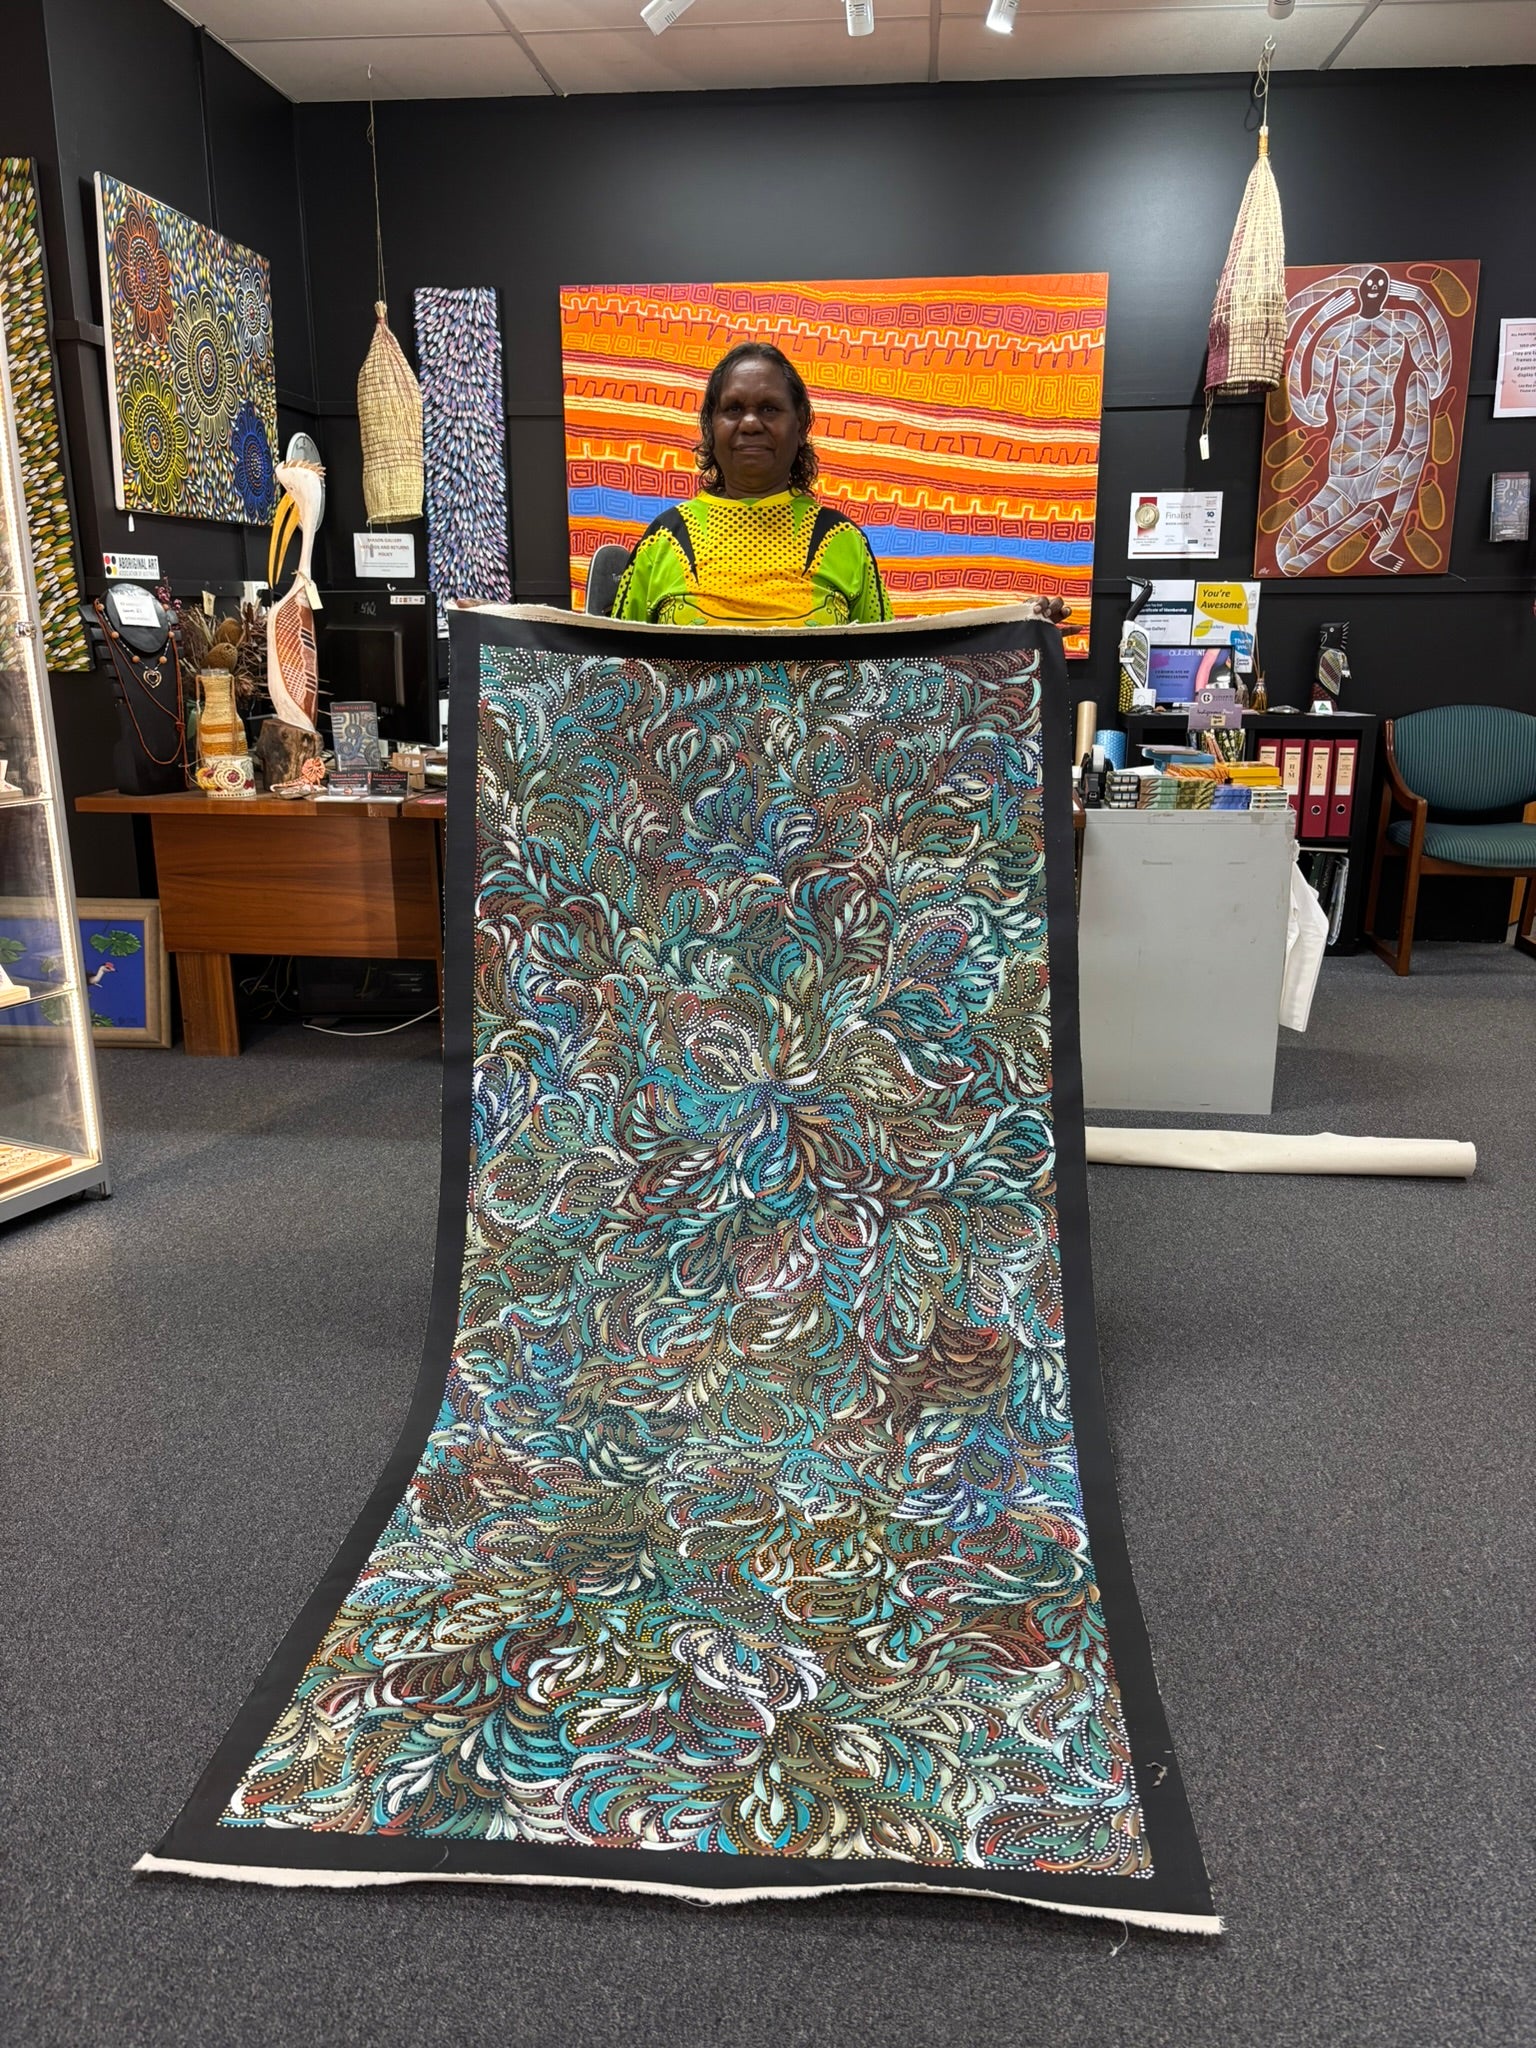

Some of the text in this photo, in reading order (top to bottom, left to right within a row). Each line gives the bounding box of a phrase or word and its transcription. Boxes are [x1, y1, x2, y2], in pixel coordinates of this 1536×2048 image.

[1165, 511, 1192, 519] Finalist
[118, 557, 158, 570] ABORIGINAL ART
[1202, 589, 1231, 598] You're
